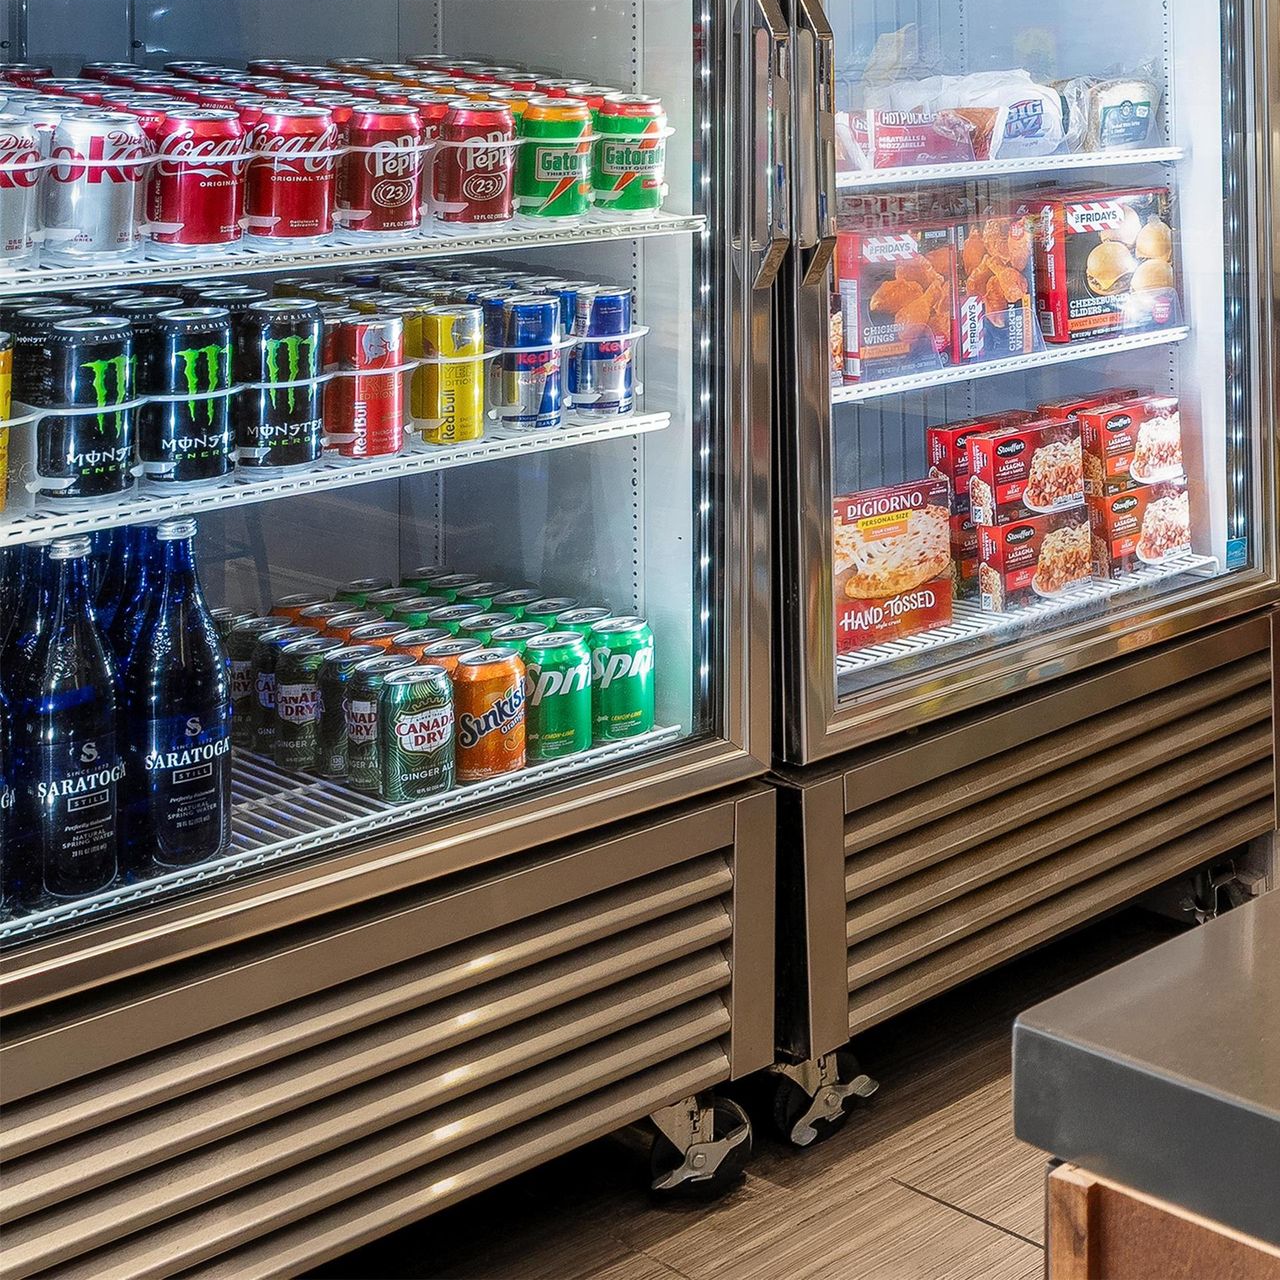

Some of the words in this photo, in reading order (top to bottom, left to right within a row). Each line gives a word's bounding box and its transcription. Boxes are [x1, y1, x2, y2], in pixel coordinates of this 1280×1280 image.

[271, 174, 313, 182] ORIGINAL
[386, 186, 404, 198] 23
[1080, 211, 1117, 223] FRIDAYS
[875, 241, 911, 254] FRIDAYS
[1070, 307, 1102, 317] SLIDERS
[863, 333, 894, 344] WINGS
[1000, 462, 1024, 472] LASAGNA
[847, 492, 923, 519] DIGIORNO
[862, 516, 893, 527] PERSONAL
[896, 512, 908, 520] SIZE
[1006, 528, 1035, 542] Stouffer's
[1009, 548, 1033, 559] LASAGNA
[840, 591, 936, 632] HAND-TOSSED
[459, 679, 528, 747] Sunkist
[396, 714, 454, 736] CANADA
[415, 728, 445, 745] DRY
[145, 737, 230, 770] SARATOGA
[400, 767, 439, 781] GINGER
[38, 764, 126, 799] SARATOGA
[74, 794, 105, 806] STILL
